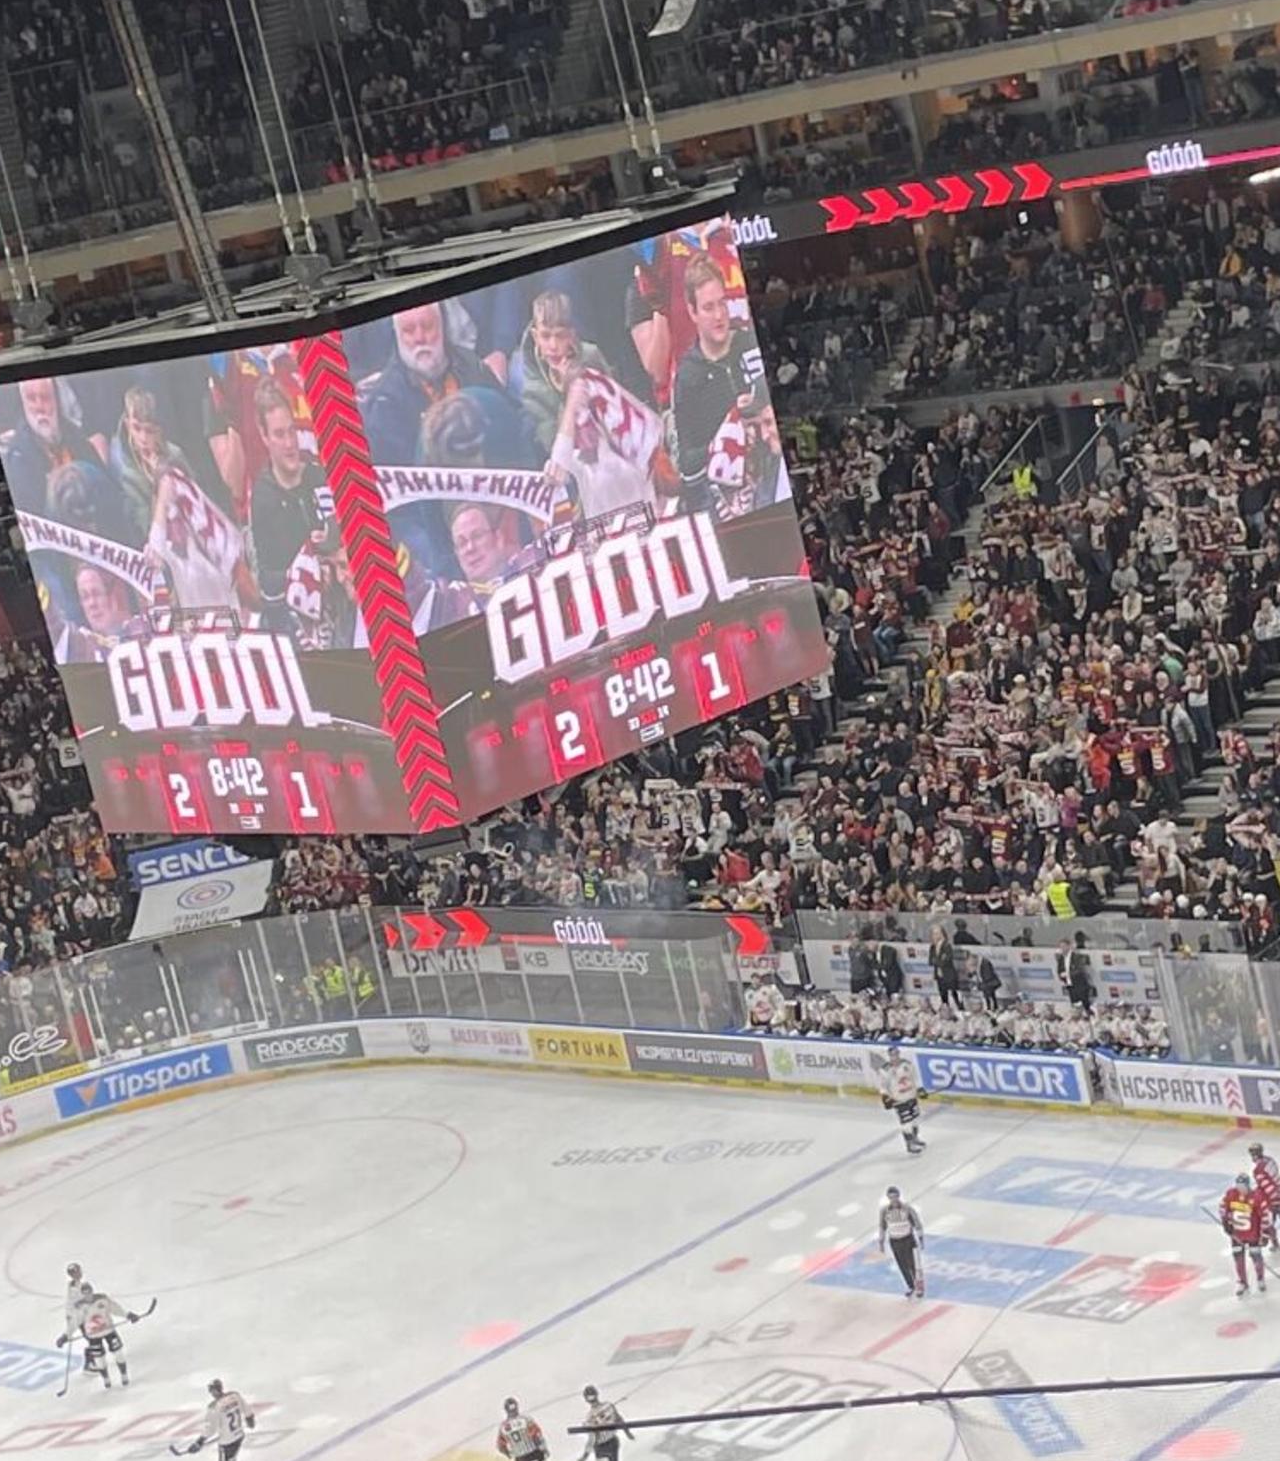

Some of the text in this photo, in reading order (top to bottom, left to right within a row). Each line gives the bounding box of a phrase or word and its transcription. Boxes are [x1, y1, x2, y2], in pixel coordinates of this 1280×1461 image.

[1146, 140, 1207, 176] GÓÓÓL
[486, 496, 749, 684] GÓÓÓL
[107, 611, 331, 732] GÓÓÓL
[605, 657, 675, 718] 8:42
[700, 652, 730, 700] 1
[555, 710, 586, 760] 2
[169, 773, 196, 817] 2
[208, 757, 268, 796] 8:42
[291, 771, 318, 817] 1
[553, 915, 611, 945] GÓÓÓL
[523, 953, 549, 968] KB
[255, 1032, 350, 1063] RADEGAST
[536, 1037, 619, 1059] FORTUNA
[103, 1051, 213, 1104] Tipsport
[927, 1055, 1068, 1099] SENCOR
[1058, 1178, 1224, 1206] DAIK
